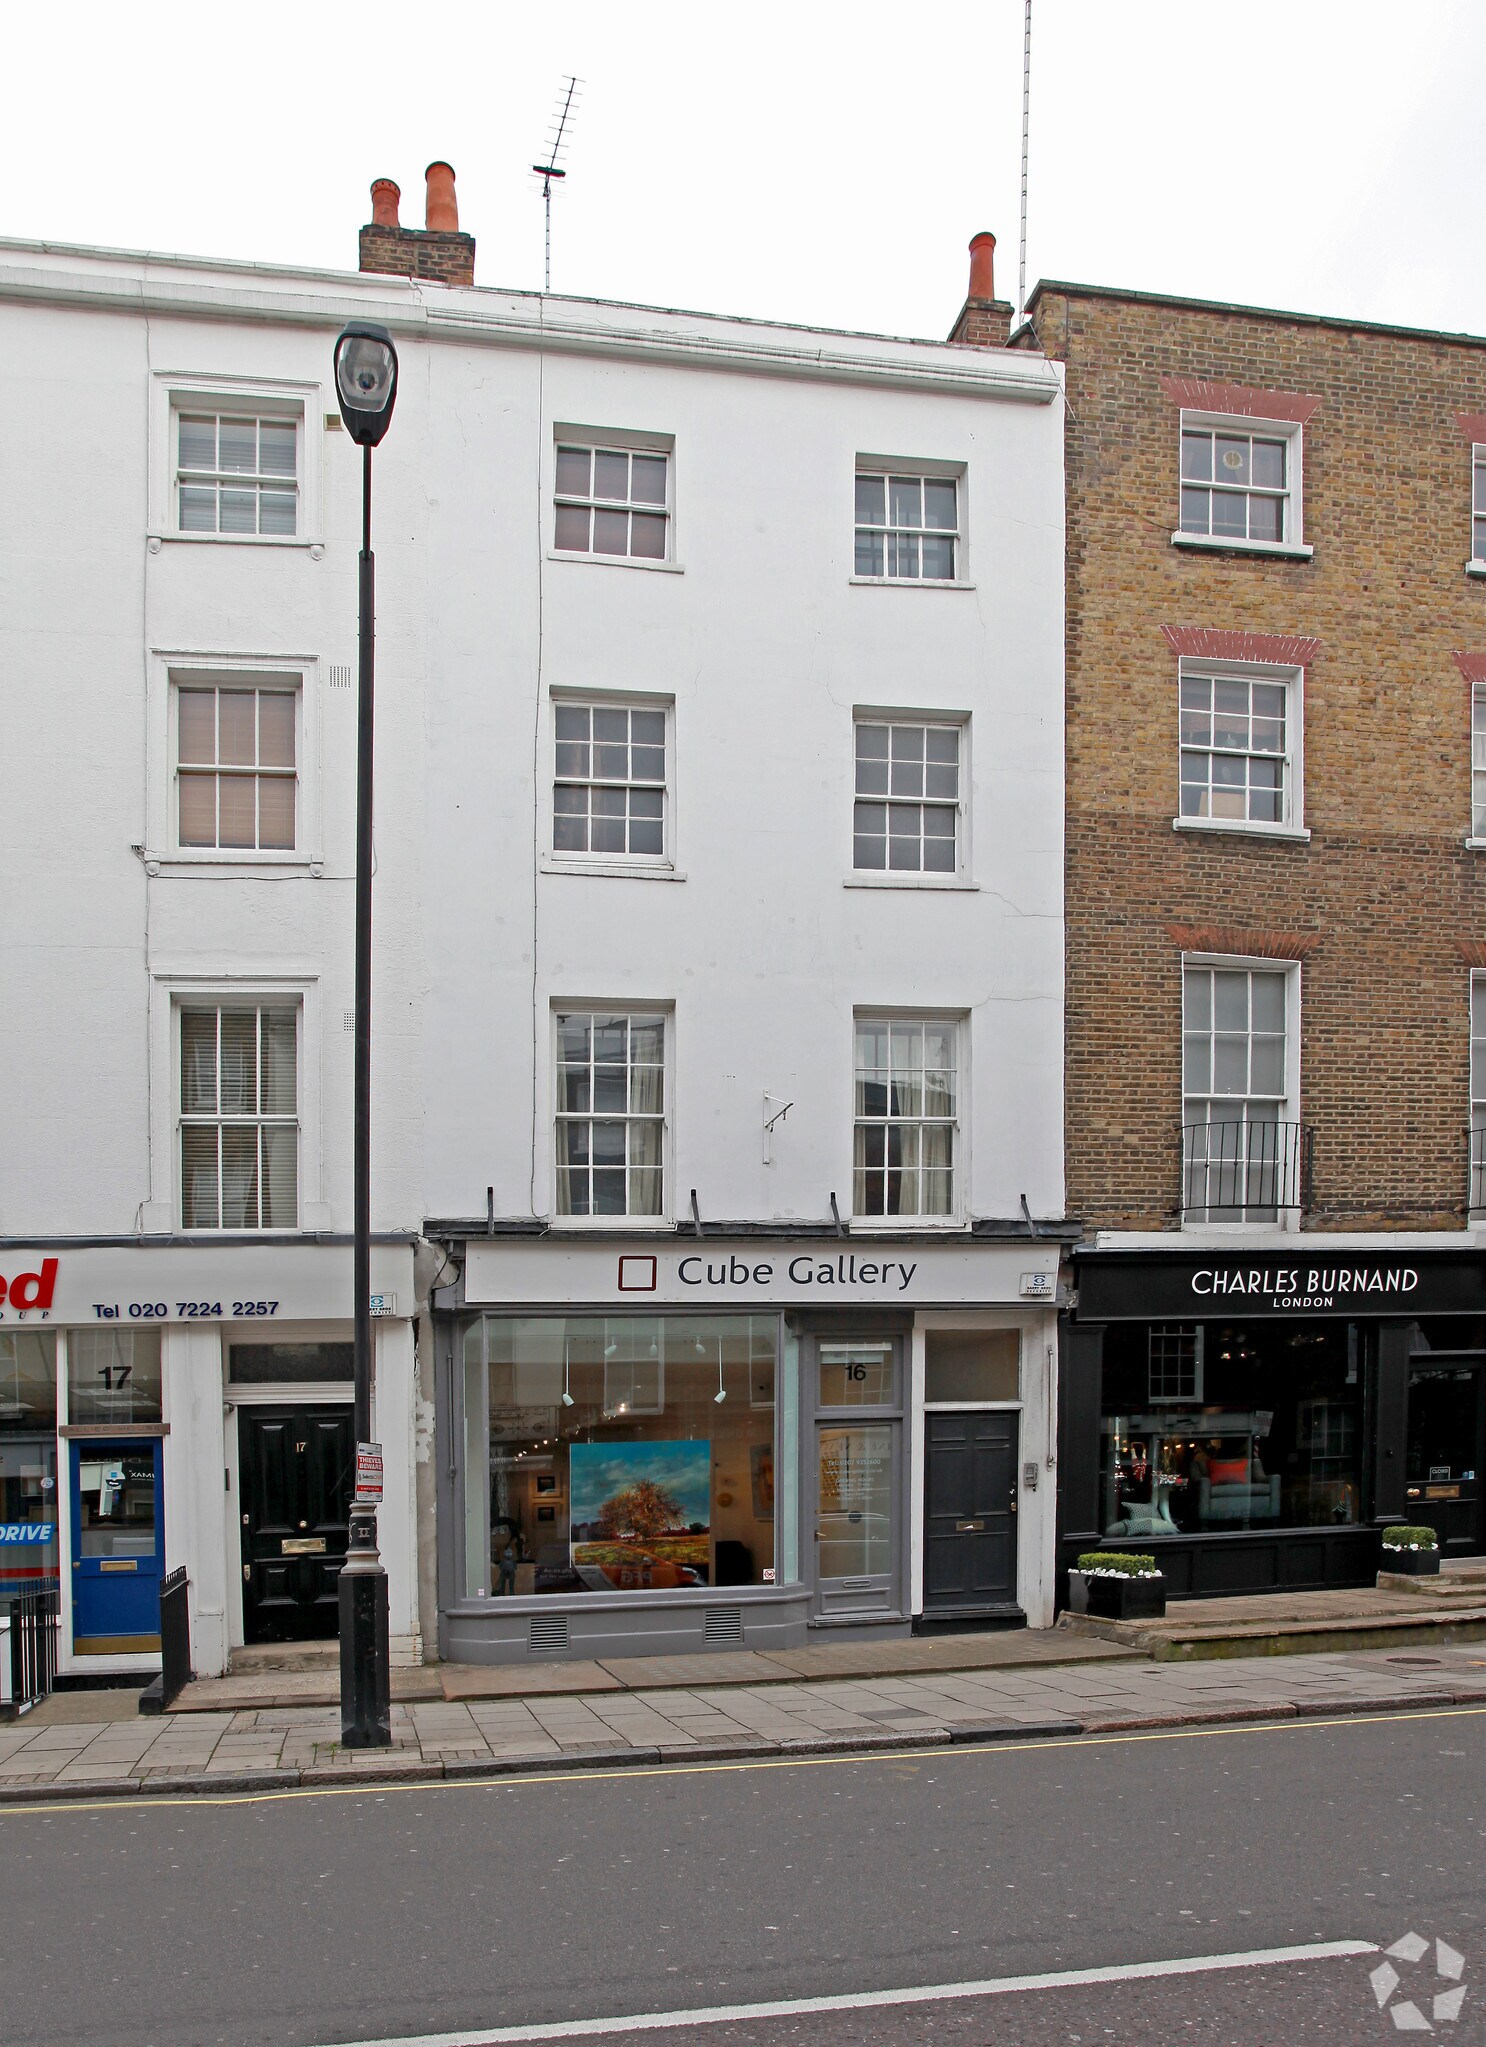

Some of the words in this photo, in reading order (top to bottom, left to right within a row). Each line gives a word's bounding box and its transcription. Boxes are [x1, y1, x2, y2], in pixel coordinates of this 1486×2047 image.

[678, 1256, 774, 1285] Cube
[788, 1255, 917, 1290] Gallery
[1191, 1269, 1299, 1294] CHARLES
[1306, 1269, 1418, 1293] BURNAND
[92, 1304, 120, 1318] Tel
[129, 1303, 168, 1318] 020
[176, 1302, 223, 1317] 7224
[232, 1301, 279, 1316] 2257
[1273, 1297, 1333, 1308] LONDON
[98, 1366, 132, 1389] 17
[845, 1364, 866, 1381] 16
[296, 1442, 306, 1452] 17
[359, 1456, 382, 1464] THIEVES
